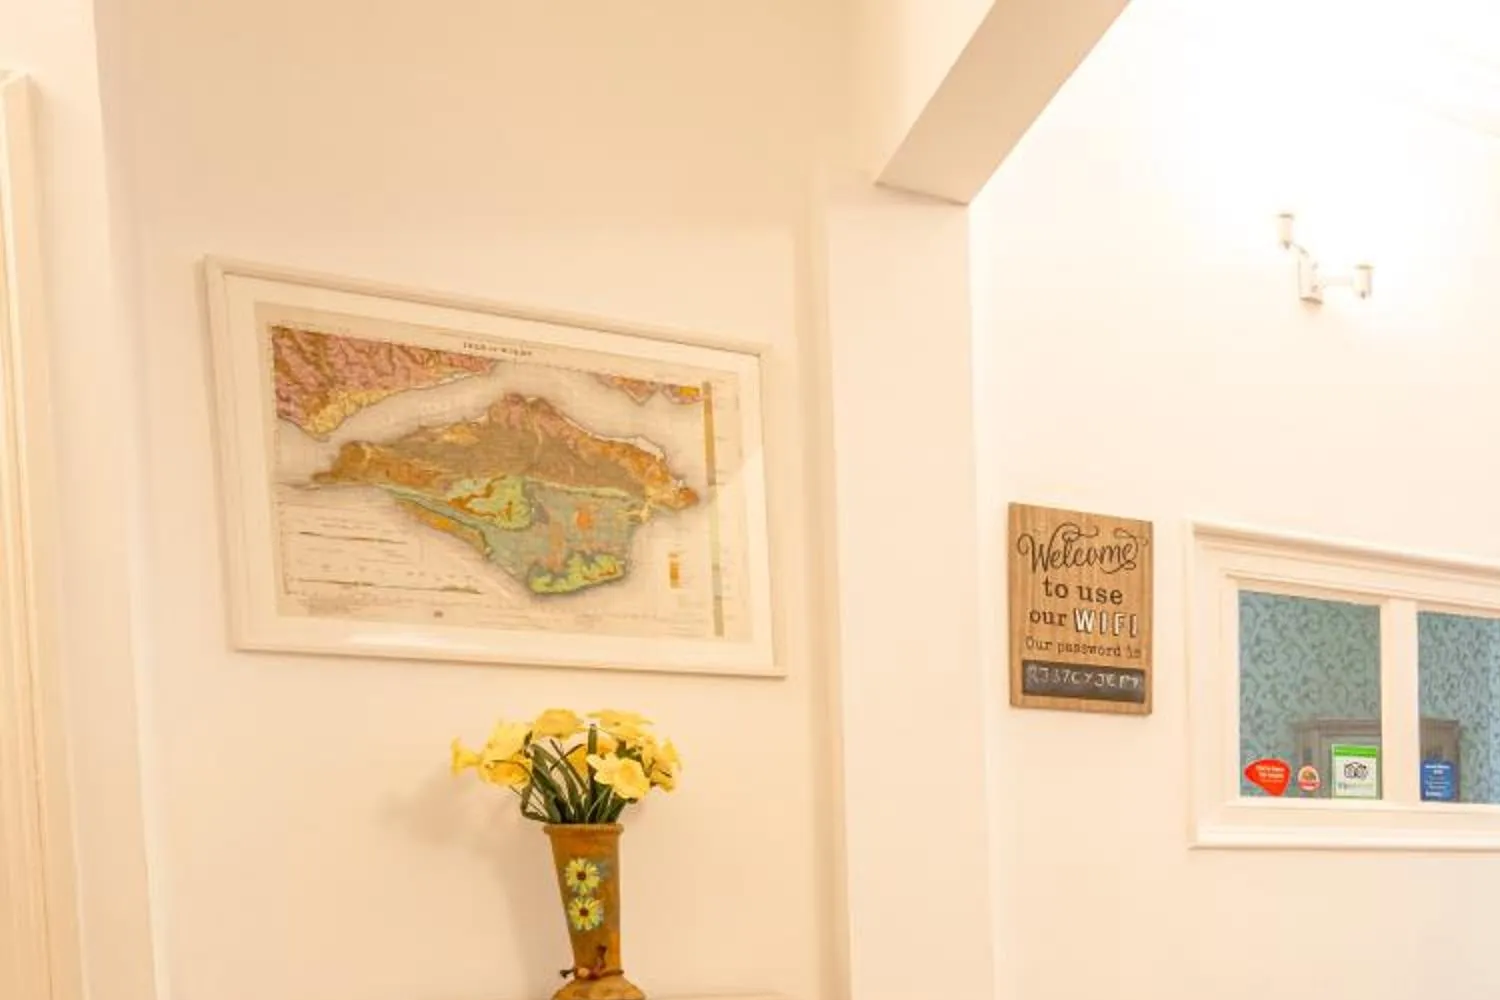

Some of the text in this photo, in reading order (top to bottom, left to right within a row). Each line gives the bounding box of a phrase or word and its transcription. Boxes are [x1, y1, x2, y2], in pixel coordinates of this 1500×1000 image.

[1018, 522, 1147, 574] Welcome
[1042, 576, 1123, 606] to use
[1029, 609, 1137, 637] our WIFI
[1025, 636, 1141, 659] Our password is
